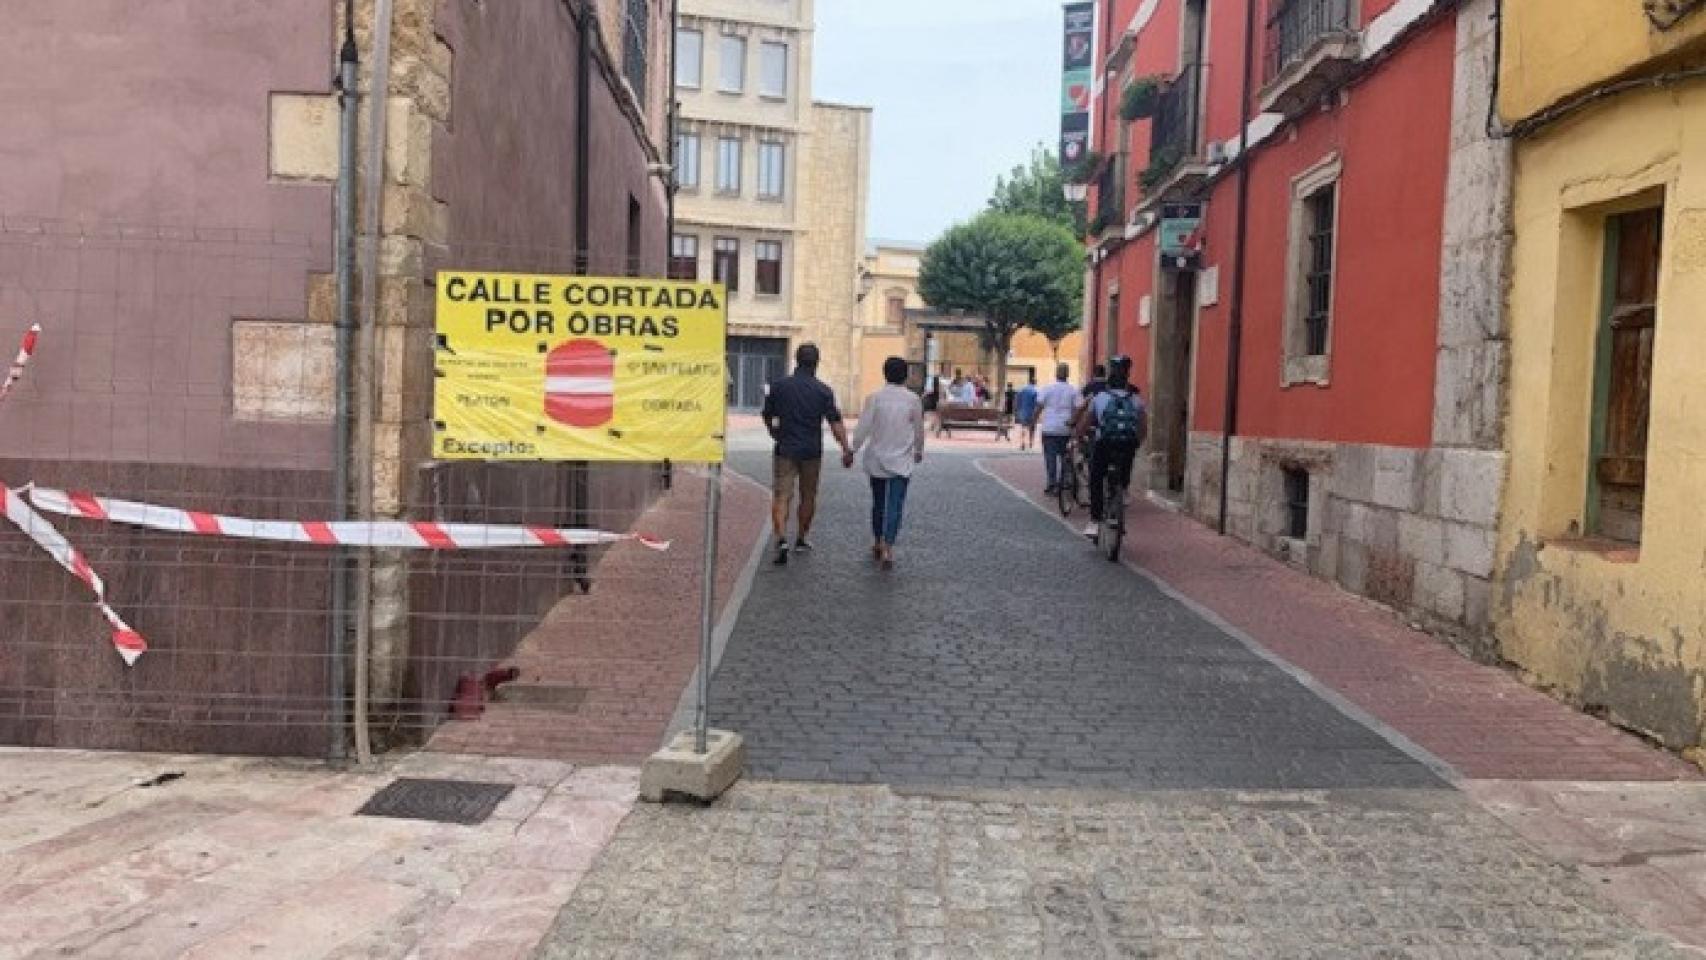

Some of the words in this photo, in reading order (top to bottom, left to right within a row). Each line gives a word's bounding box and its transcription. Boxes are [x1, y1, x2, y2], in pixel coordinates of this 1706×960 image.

[446, 277, 552, 304] CALLE
[564, 284, 719, 309] CORTADA
[486, 308, 554, 333] POR
[568, 311, 679, 338] OBRAS
[443, 437, 536, 456] Excepto:
